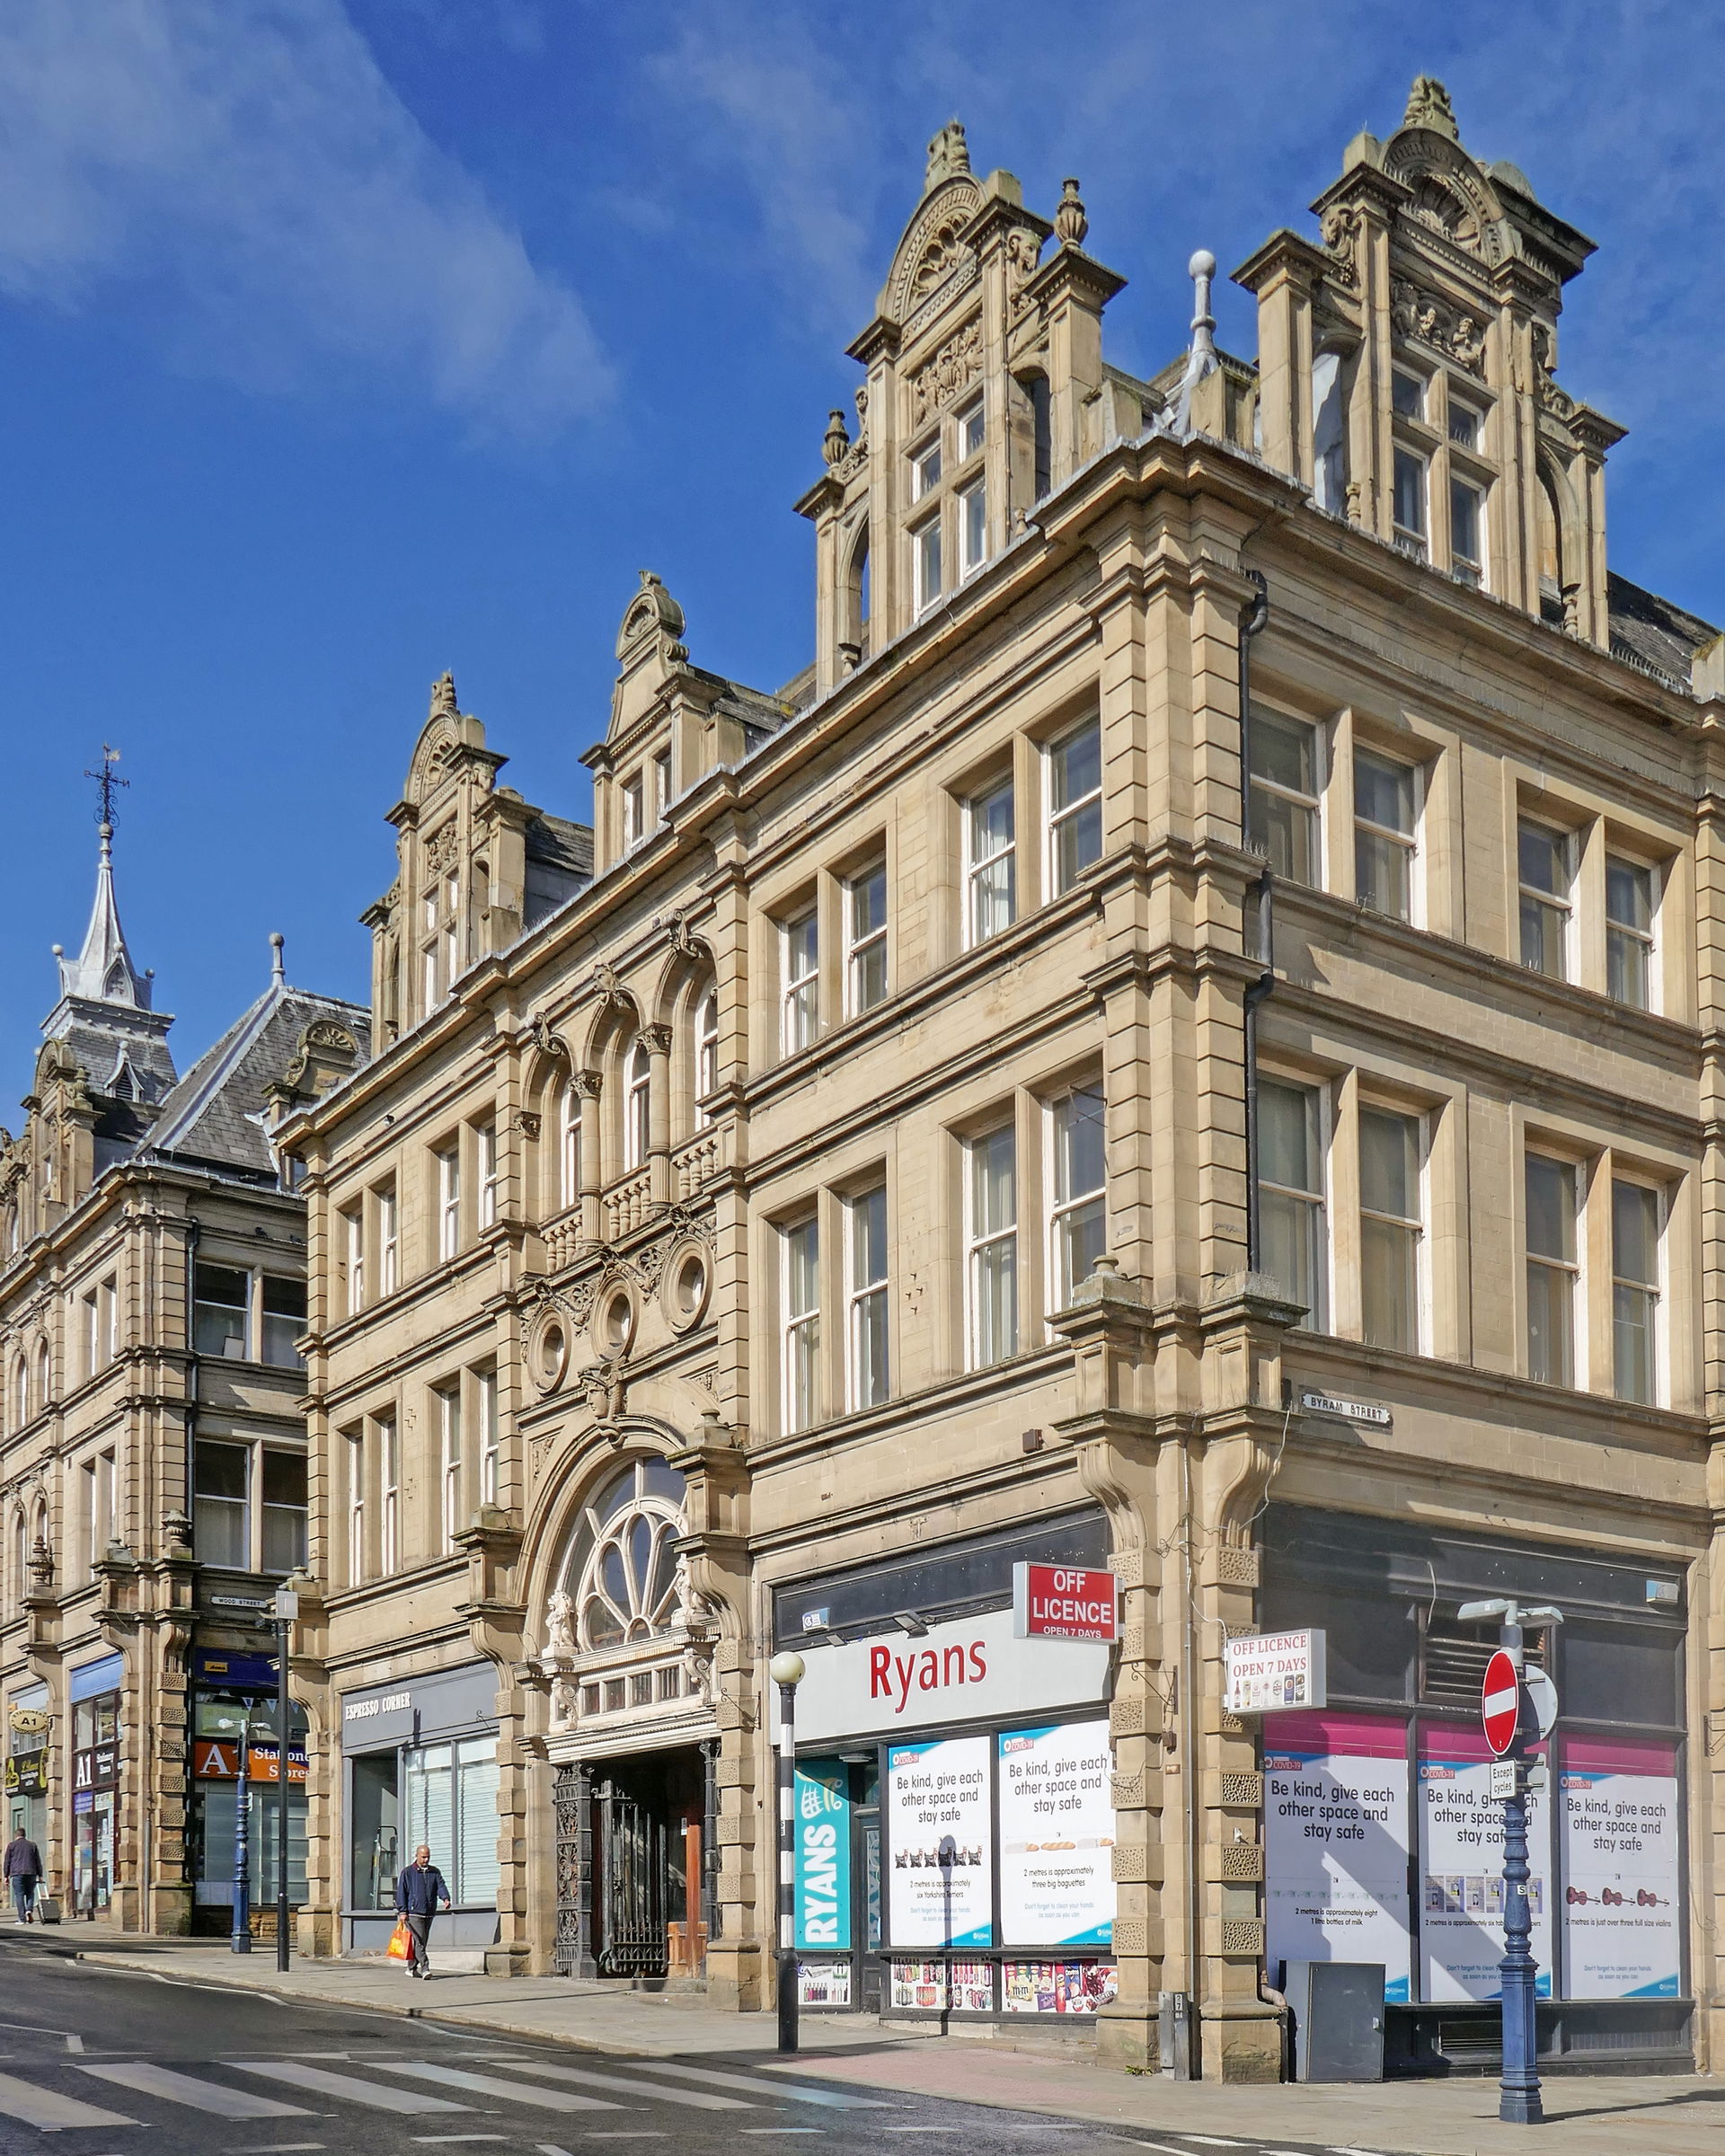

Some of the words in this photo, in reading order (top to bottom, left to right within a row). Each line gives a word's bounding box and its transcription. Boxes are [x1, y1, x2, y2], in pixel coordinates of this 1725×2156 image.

[1311, 1397, 1343, 1413] BYRAM
[1350, 1404, 1382, 1419] STREET
[1054, 1570, 1086, 1593] OFF
[1033, 1597, 1111, 1624] LICENCE
[1043, 1626, 1068, 1636] OPEN
[1070, 1628, 1076, 1636] 7
[1078, 1629, 1101, 1639] DAYS
[1234, 1641, 1255, 1657] OFF
[1258, 1635, 1306, 1653] LICENCE
[871, 1640, 986, 1713] Ryans
[1234, 1662, 1264, 1677] OPEN
[1268, 1661, 1274, 1674] 7
[1278, 1657, 1306, 1673] DAYS
[345, 1699, 379, 1720] ESPRESSO
[382, 1692, 411, 1713] CORNER
[22, 1717, 37, 1726] A1
[75, 1753, 93, 1788] A1
[1009, 1764, 1022, 1778] Be
[1026, 1760, 1051, 1776] kind,
[1055, 1758, 1076, 1777] give
[1080, 1754, 1107, 1771] each
[1272, 1761, 1301, 1770] COVID-19
[1429, 1770, 1455, 1779] COVID-19
[1493, 1767, 1513, 1780] Except
[897, 1776, 908, 1789] Be
[911, 1772, 933, 1789] kind,
[936, 1772, 957, 1790] give
[960, 1769, 984, 1784] each
[1014, 1780, 1042, 1796] other
[1045, 1780, 1076, 1797] space
[1080, 1773, 1101, 1789] and
[1493, 1780, 1512, 1794] cycles
[1568, 1780, 1591, 1789] COVID-19
[901, 1792, 925, 1807] other
[928, 1792, 957, 1807] space
[960, 1787, 978, 1802] and
[1271, 1780, 1289, 1796] Be
[1294, 1780, 1326, 1800] kind,
[1331, 1784, 1358, 1803] give
[1363, 1787, 1394, 1802] each
[1428, 1789, 1443, 1803] Be
[1447, 1788, 1477, 1807] kind,
[1526, 1794, 1538, 1807] ch
[1033, 1798, 1056, 1816] stay
[1058, 1794, 1082, 1811] safe
[1278, 1800, 1314, 1817] other
[1319, 1806, 1358, 1822] space
[1363, 1806, 1388, 1821] and
[1567, 1798, 1581, 1811] Be
[1585, 1798, 1611, 1816] kind,
[1614, 1800, 1637, 1817] give
[1641, 1803, 1667, 1817] each
[918, 1810, 938, 1825] stay
[940, 1807, 961, 1822] safe
[1434, 1807, 1467, 1824] other
[1471, 1813, 1505, 1827] space
[1573, 1816, 1602, 1831] other
[1606, 1820, 1637, 1834] space
[1641, 1820, 1661, 1834] and
[1304, 1823, 1331, 1842] stay
[1337, 1824, 1365, 1840] safe
[1457, 1828, 1482, 1846] stay
[1486, 1829, 1505, 1843] saf
[1593, 1836, 1616, 1853] stay
[1619, 1836, 1642, 1851] safe
[1023, 1869, 1028, 1877] 2
[1029, 1869, 1048, 1877] metres
[1054, 1865, 1094, 1878] approximately
[803, 1824, 838, 1943] RYANS
[910, 1880, 914, 1888] 2
[1048, 1880, 1057, 1889] big
[1057, 1879, 1085, 1889] baguettes
[1325, 1908, 1363, 1918] approximately
[1364, 1909, 1378, 1919] eight
[1565, 1917, 1570, 1926] 2
[1590, 1918, 1596, 1926] is
[1596, 1919, 1606, 1928] just
[1620, 1919, 1633, 1927] three
[1634, 1919, 1643, 1927] full
[1643, 1919, 1654, 1927] size
[1453, 1919, 1487, 1928] approximately
